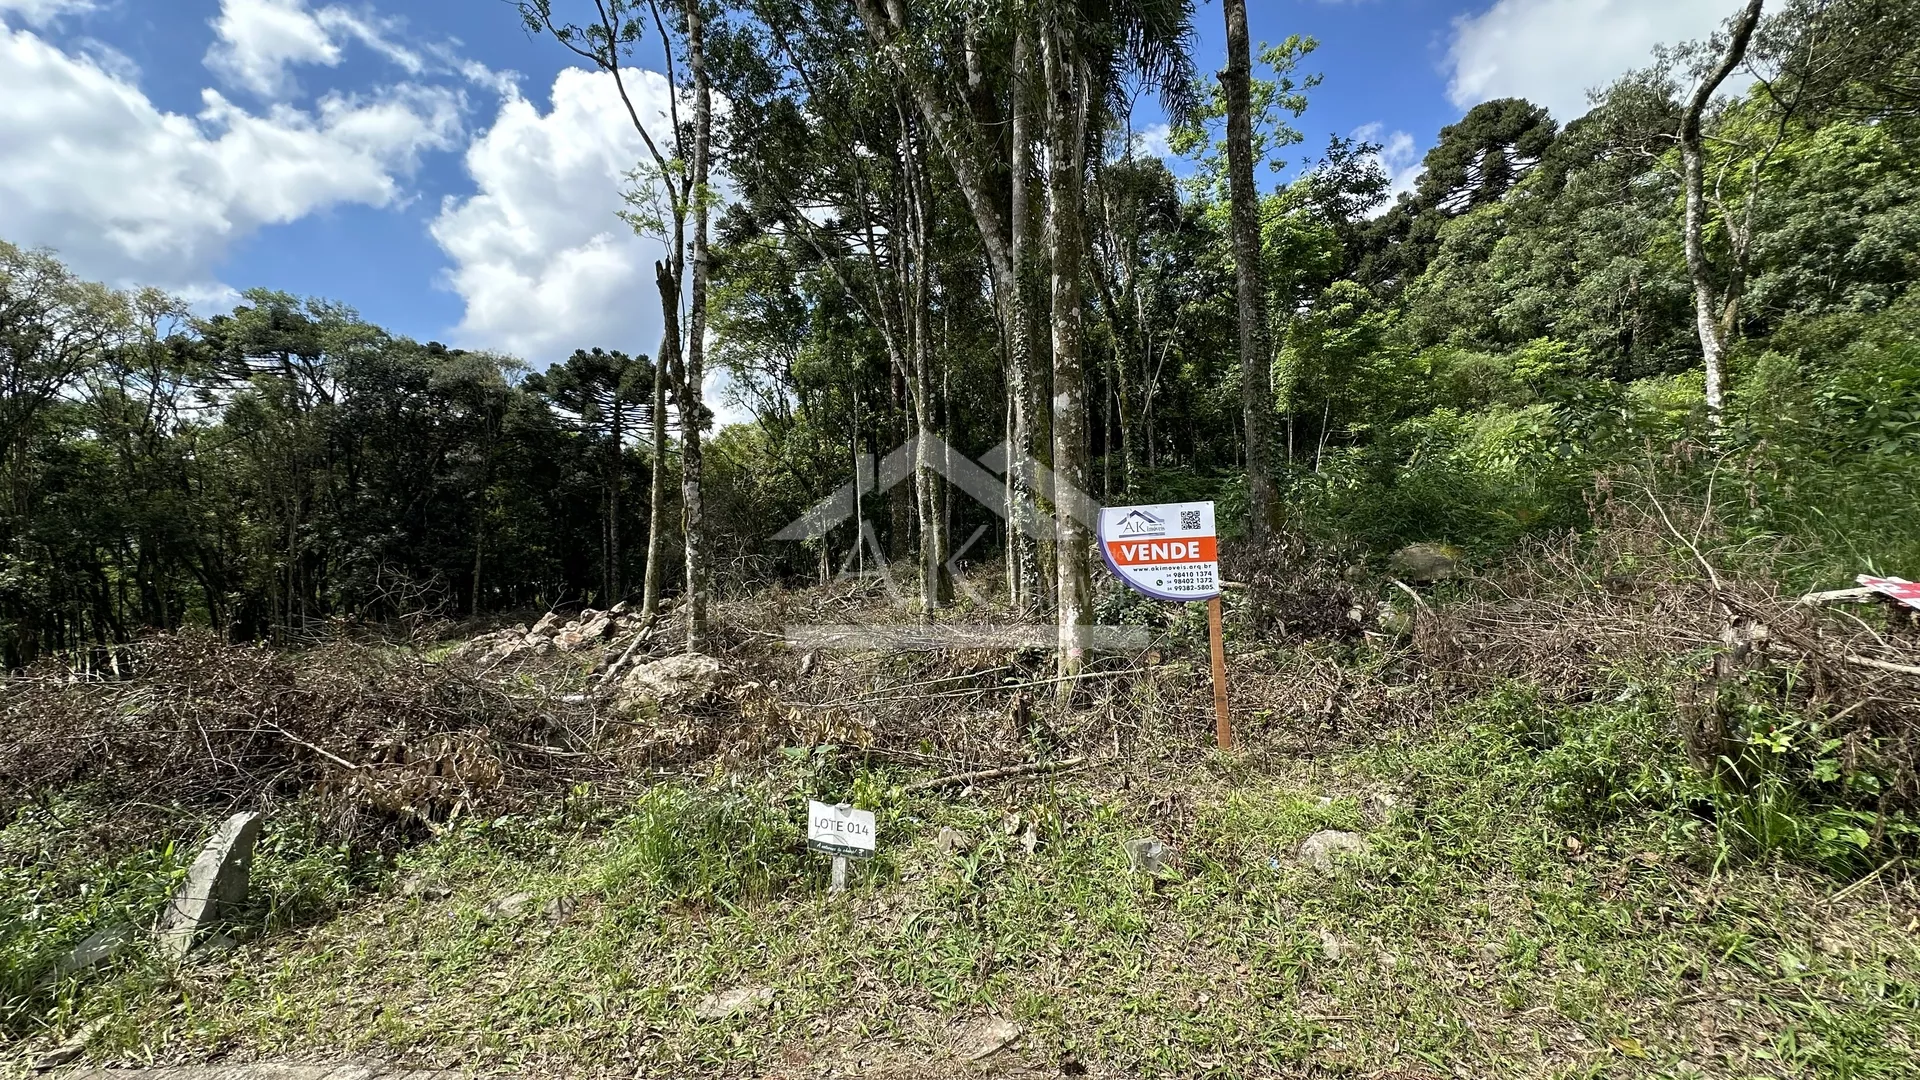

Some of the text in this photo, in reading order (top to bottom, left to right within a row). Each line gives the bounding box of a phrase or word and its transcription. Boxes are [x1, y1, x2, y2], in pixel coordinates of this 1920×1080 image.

[1122, 521, 1146, 533] AK
[1120, 541, 1200, 561] VENDE
[1133, 564, 1212, 572] www.akimoveis.arq.br
[814, 817, 869, 836] LOTE 014
